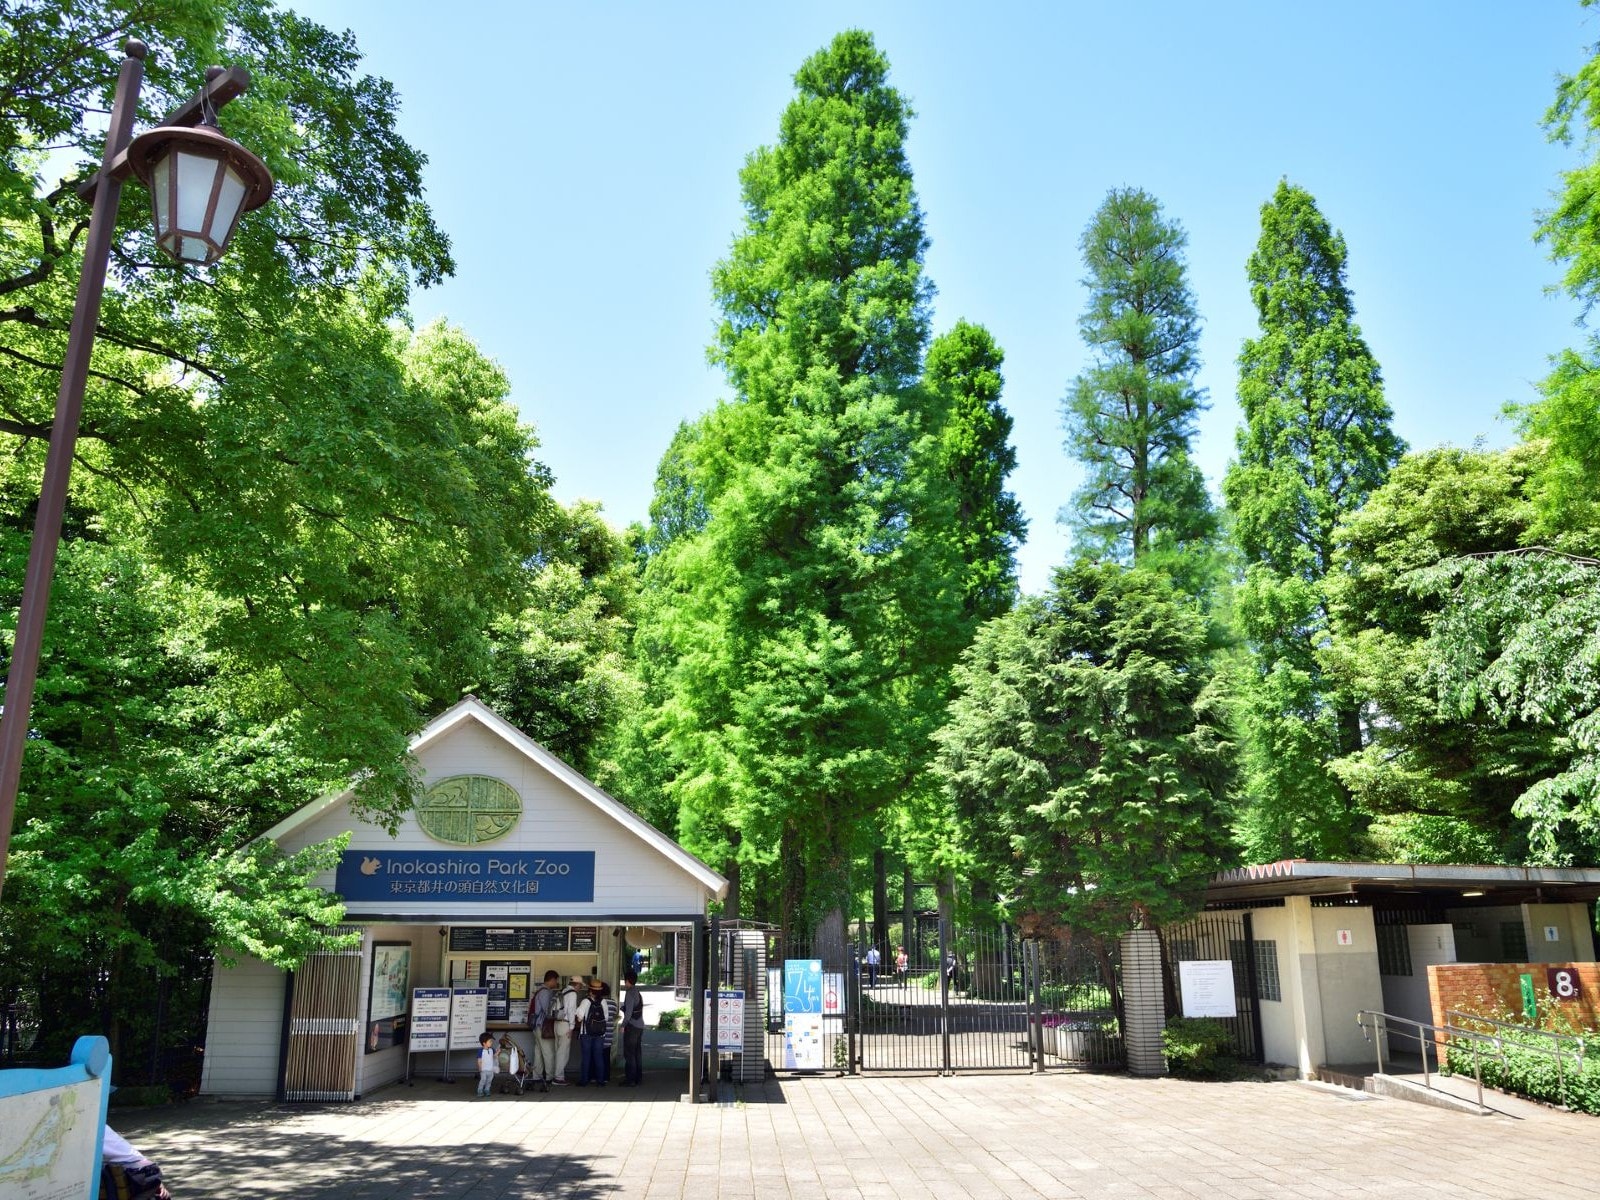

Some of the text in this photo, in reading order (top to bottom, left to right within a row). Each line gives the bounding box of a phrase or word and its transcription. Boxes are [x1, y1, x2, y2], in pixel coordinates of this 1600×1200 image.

[387, 859, 570, 875] Inokashira Park Zoo
[390, 880, 539, 894] 東京都井の頭自然文化園
[1556, 971, 1573, 996] 8
